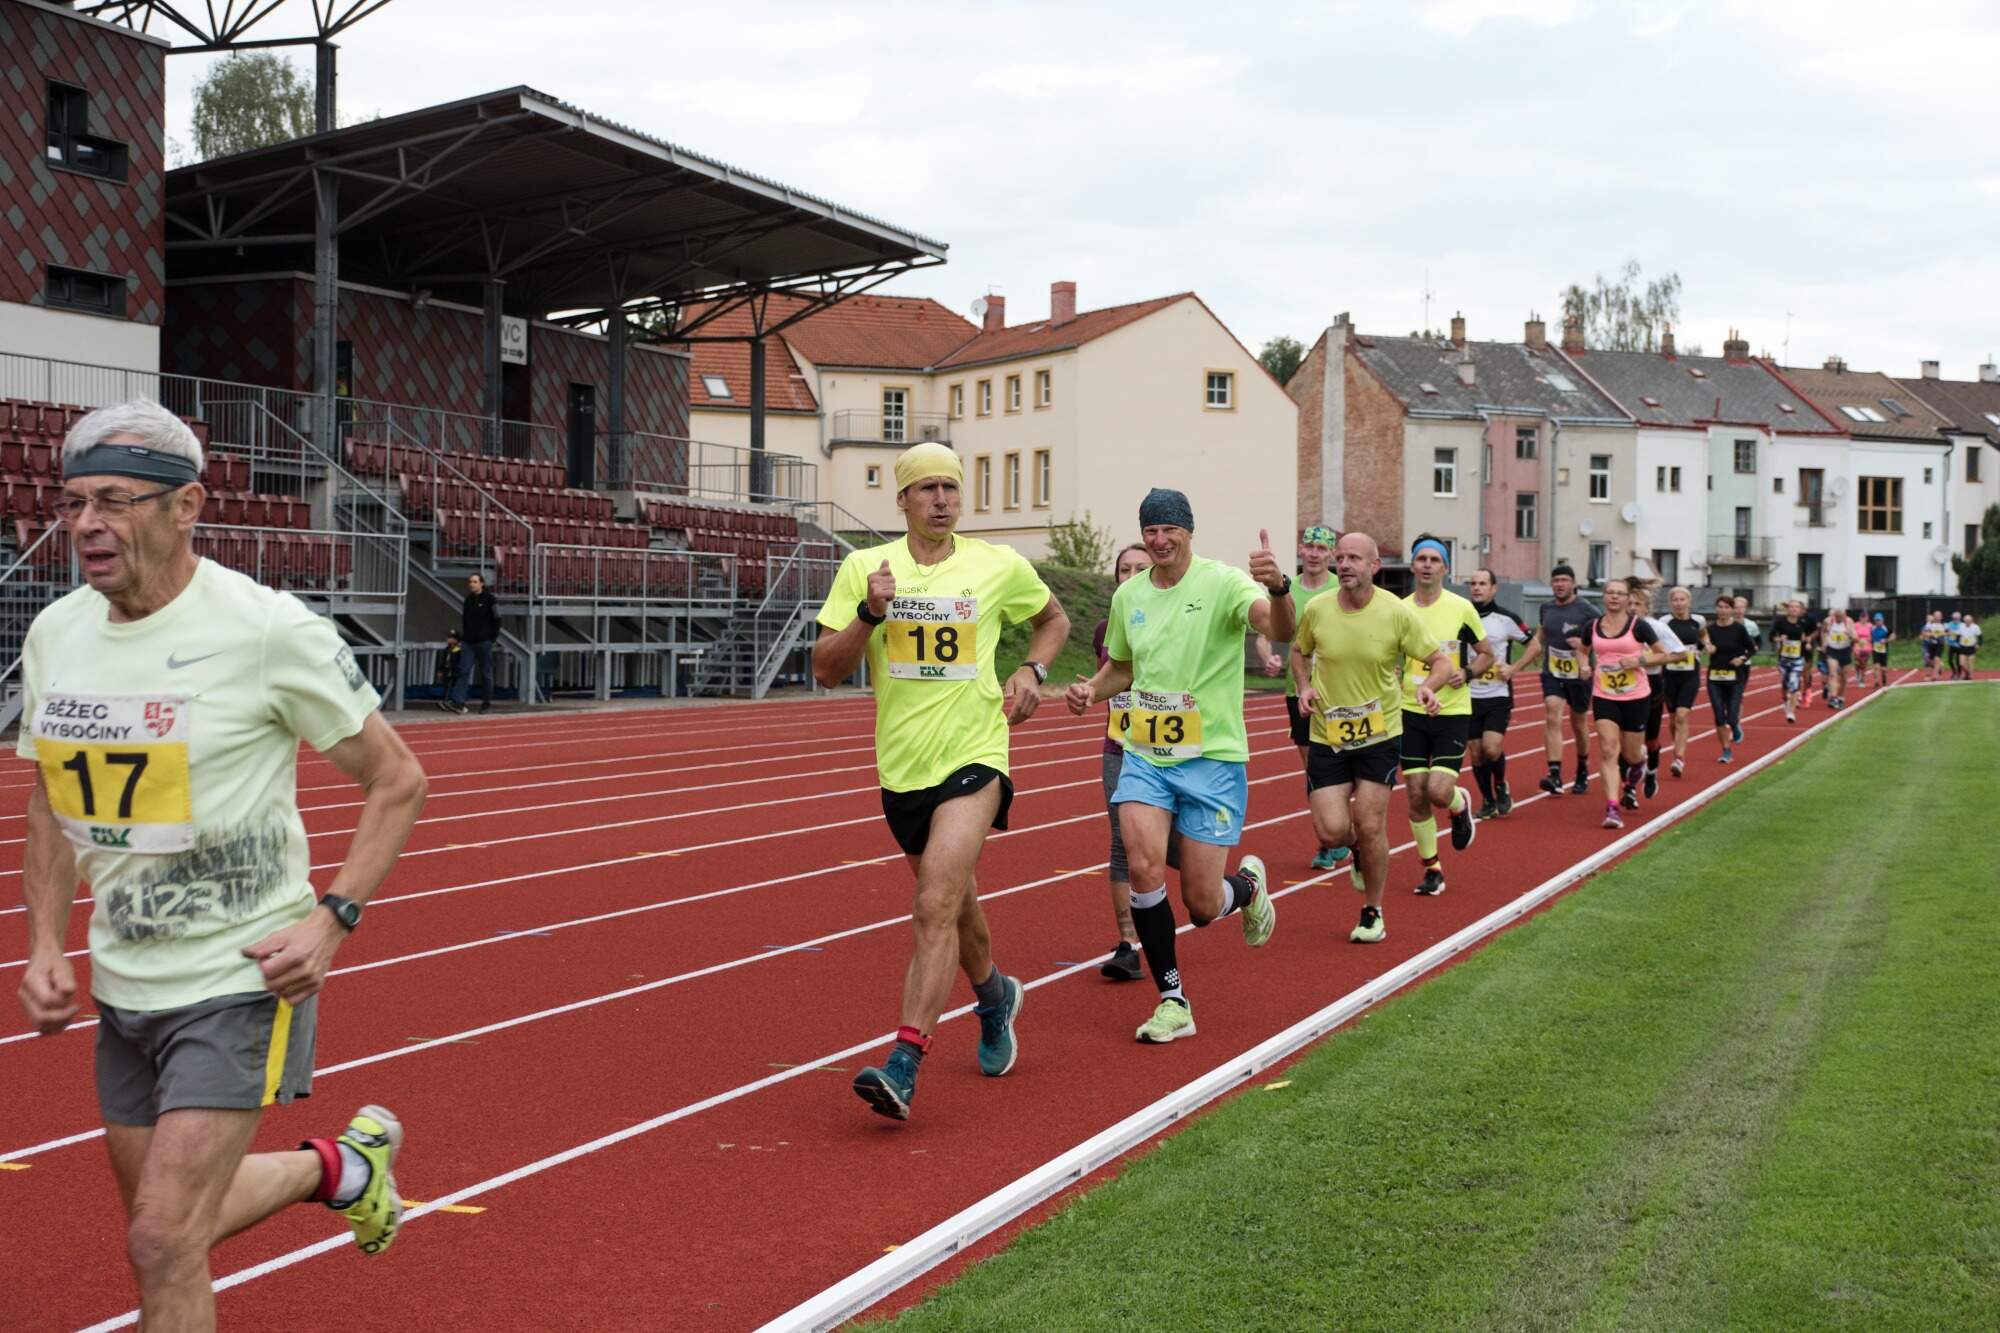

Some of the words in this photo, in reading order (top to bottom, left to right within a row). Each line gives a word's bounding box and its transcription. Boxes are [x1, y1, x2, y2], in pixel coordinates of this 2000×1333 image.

[892, 600, 936, 611] BĚŽEC
[892, 611, 951, 621] VYSOČINY
[908, 625, 959, 662] 18
[1607, 672, 1629, 689] 32
[45, 700, 109, 720] BĚŽEC
[40, 721, 132, 740] VYSOČINY
[1145, 715, 1185, 744] 13
[1339, 717, 1374, 743] 34
[62, 751, 149, 818] 17
